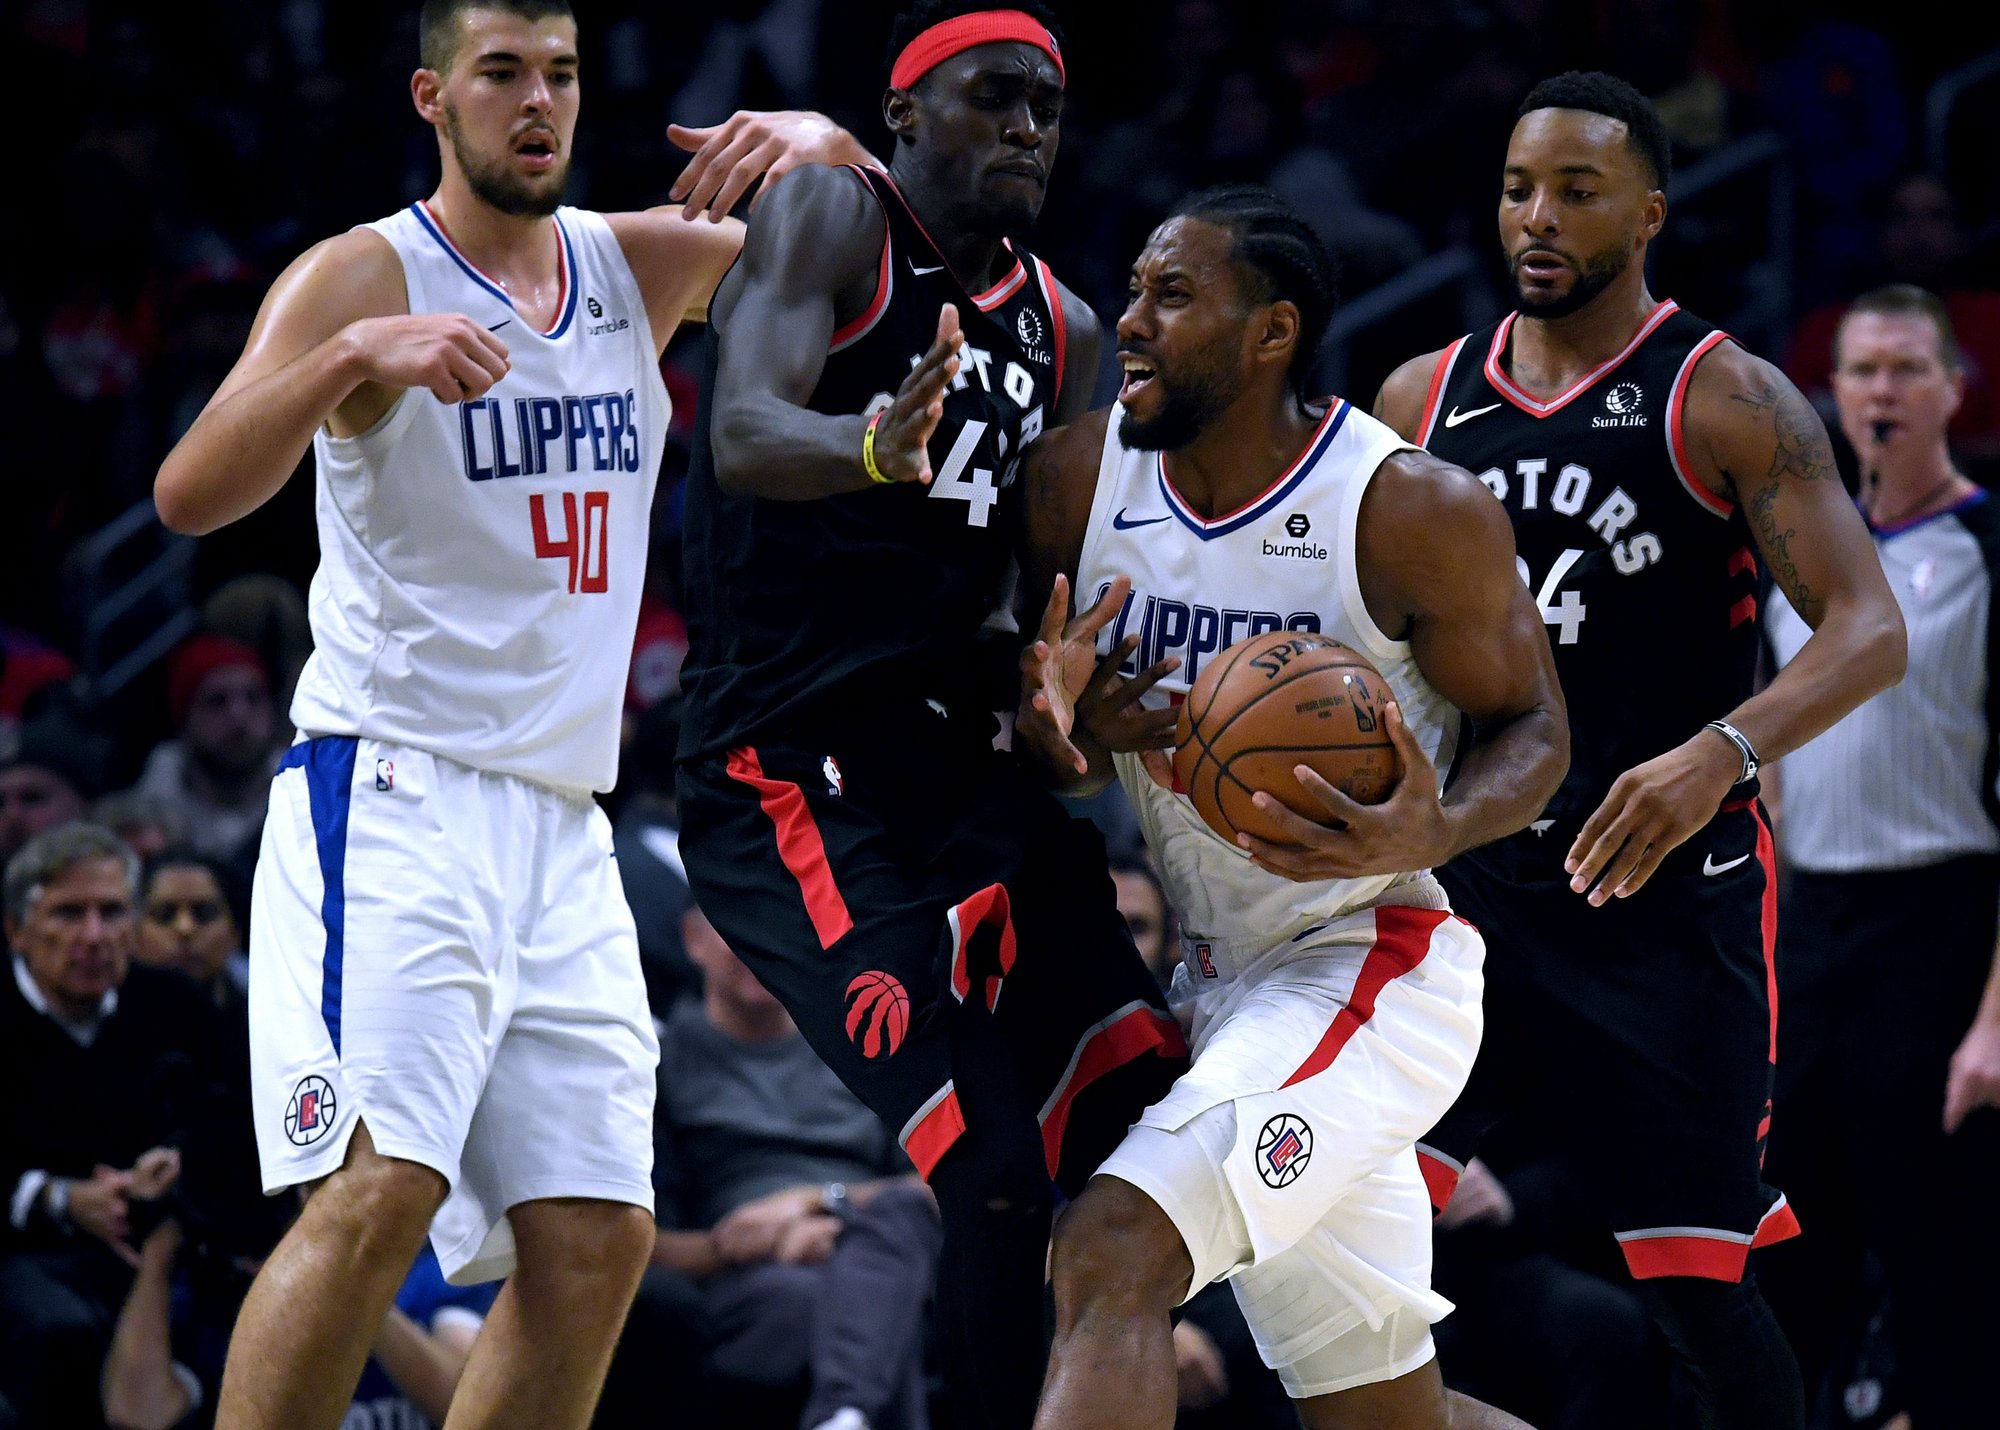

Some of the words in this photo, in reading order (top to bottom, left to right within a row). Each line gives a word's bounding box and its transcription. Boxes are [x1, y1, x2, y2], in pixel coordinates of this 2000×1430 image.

[1028, 347, 1051, 365] Life
[459, 388, 638, 481] CLIPPERS
[1592, 416, 1619, 428] Sun
[1620, 414, 1648, 427] Life
[928, 419, 1008, 527] 4
[529, 492, 609, 594] 40
[1262, 538, 1328, 560] bumble
[1516, 547, 1587, 645] 4
